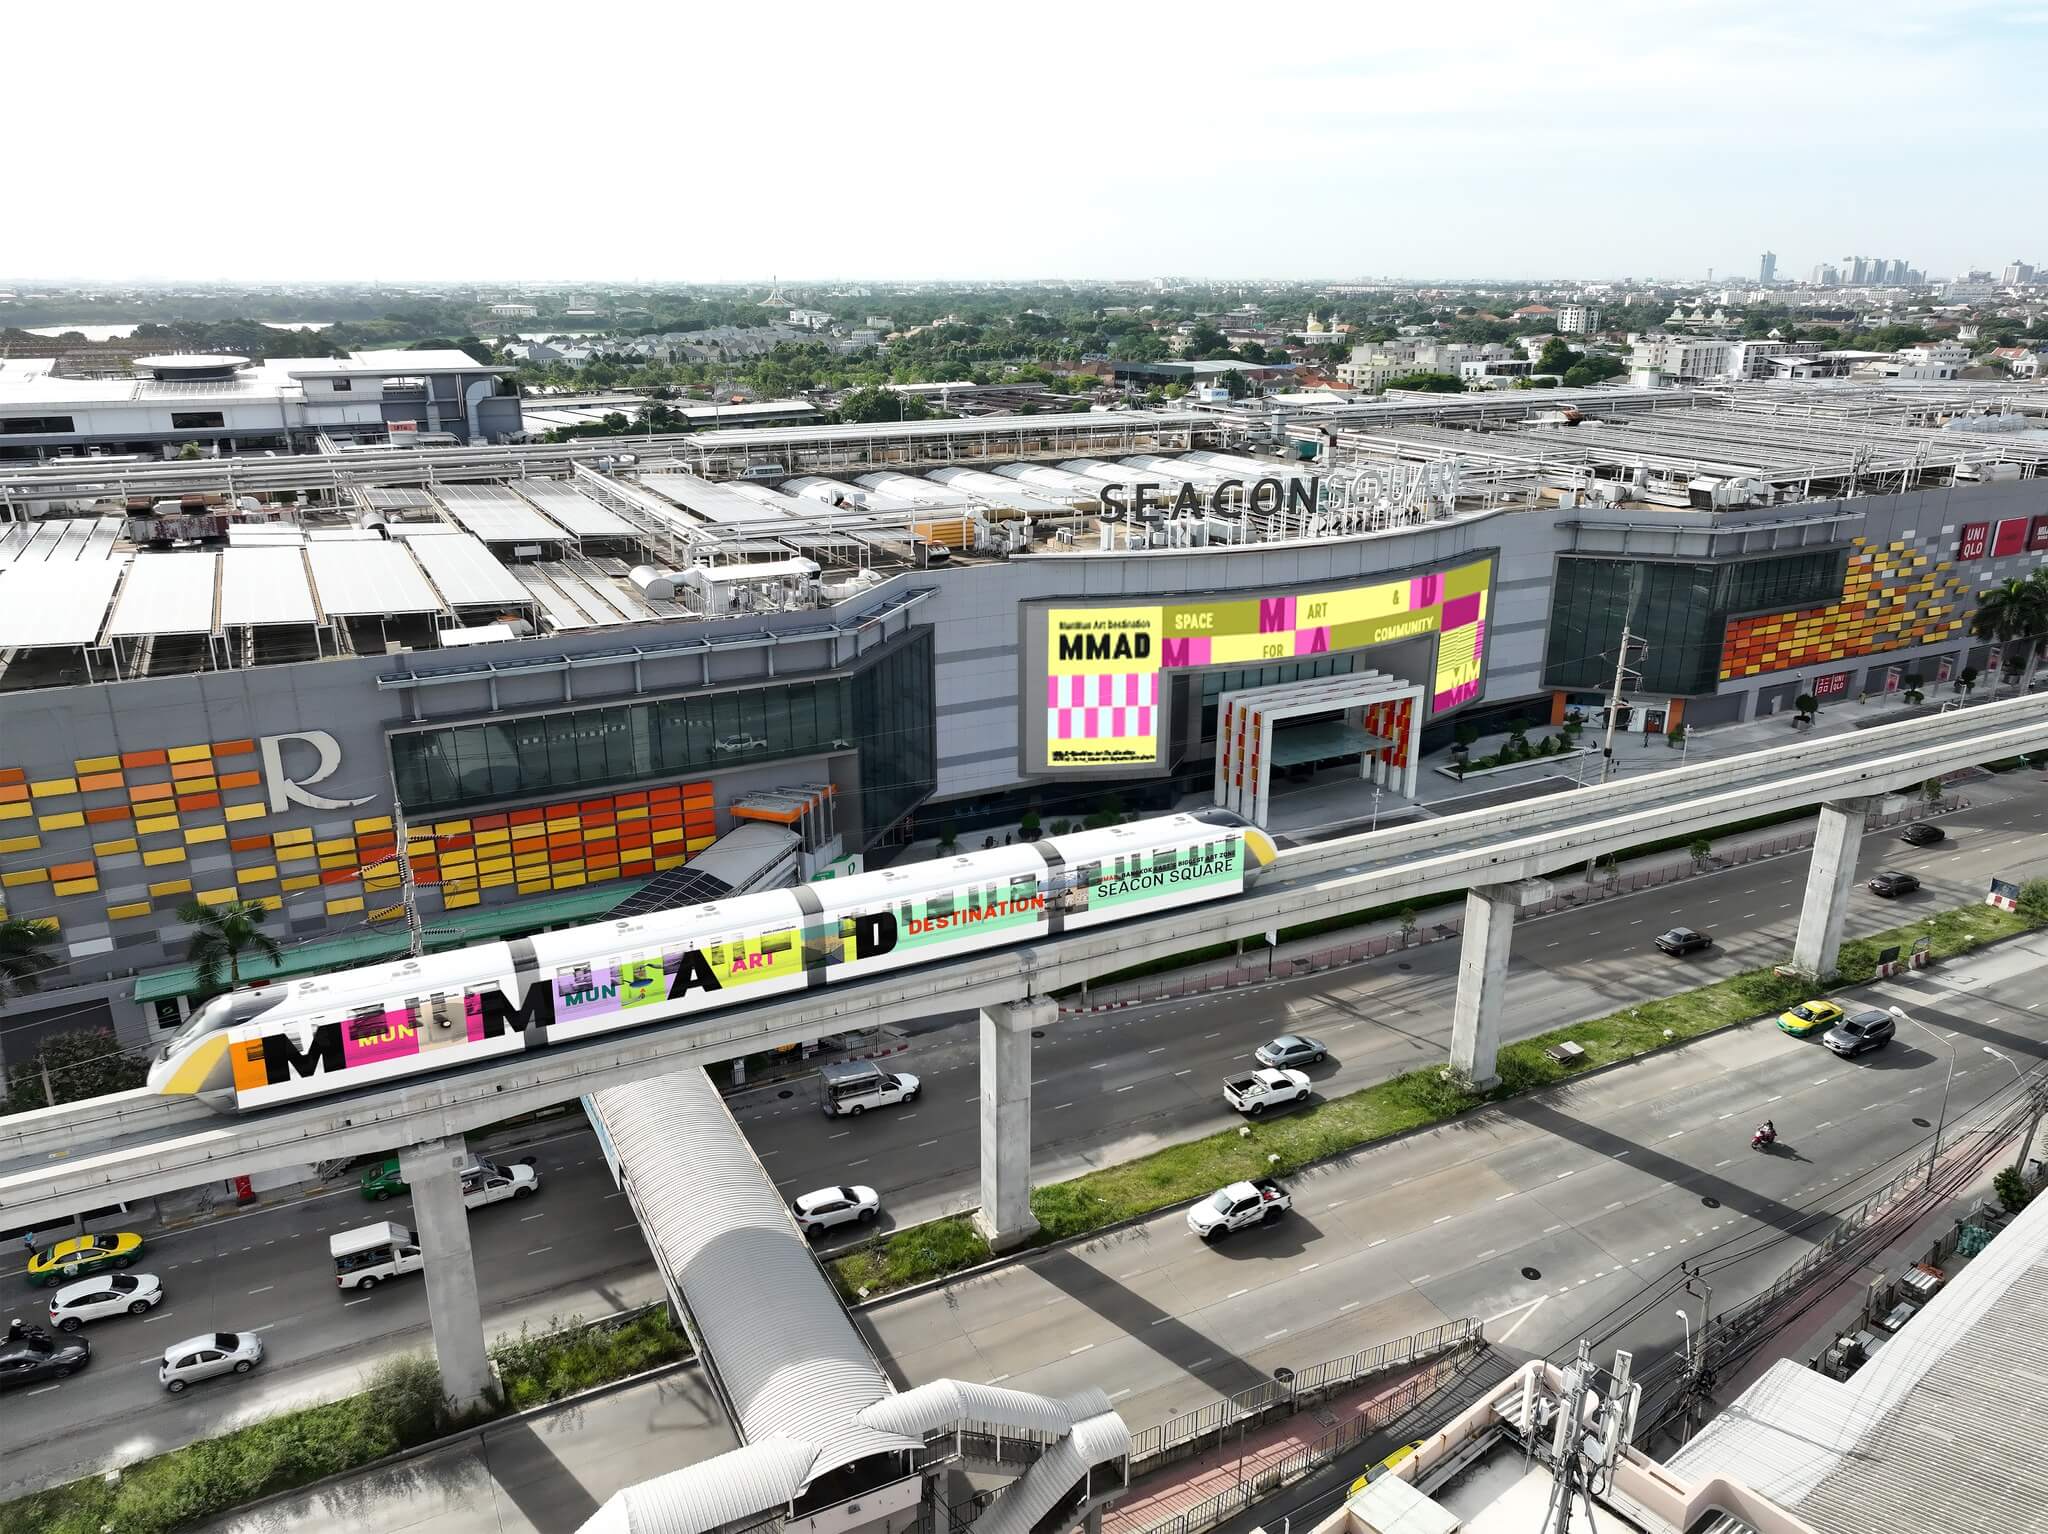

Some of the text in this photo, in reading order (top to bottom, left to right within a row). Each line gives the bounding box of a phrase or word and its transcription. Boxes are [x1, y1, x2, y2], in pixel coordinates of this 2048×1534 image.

[1100, 476, 1319, 523] SEACON
[1963, 542, 1983, 558] QLO
[1967, 527, 1985, 541] UNI
[1175, 612, 1214, 630] SPACE
[1307, 602, 1328, 620] ART
[1392, 589, 1400, 605] &
[1059, 632, 1150, 660] MMAD
[1263, 644, 1284, 658] FOR
[1374, 616, 1434, 643] COMMUNITY
[260, 729, 378, 814] R
[1098, 859, 1233, 898] SEACON SQUARE
[908, 893, 1045, 935] DESTINATION
[856, 911, 898, 960] D
[667, 950, 722, 1000] A
[732, 948, 773, 973] ART
[480, 979, 556, 1038] M
[565, 984, 616, 1007] MUN
[262, 1021, 347, 1086] M
[358, 1022, 415, 1048] MUN
